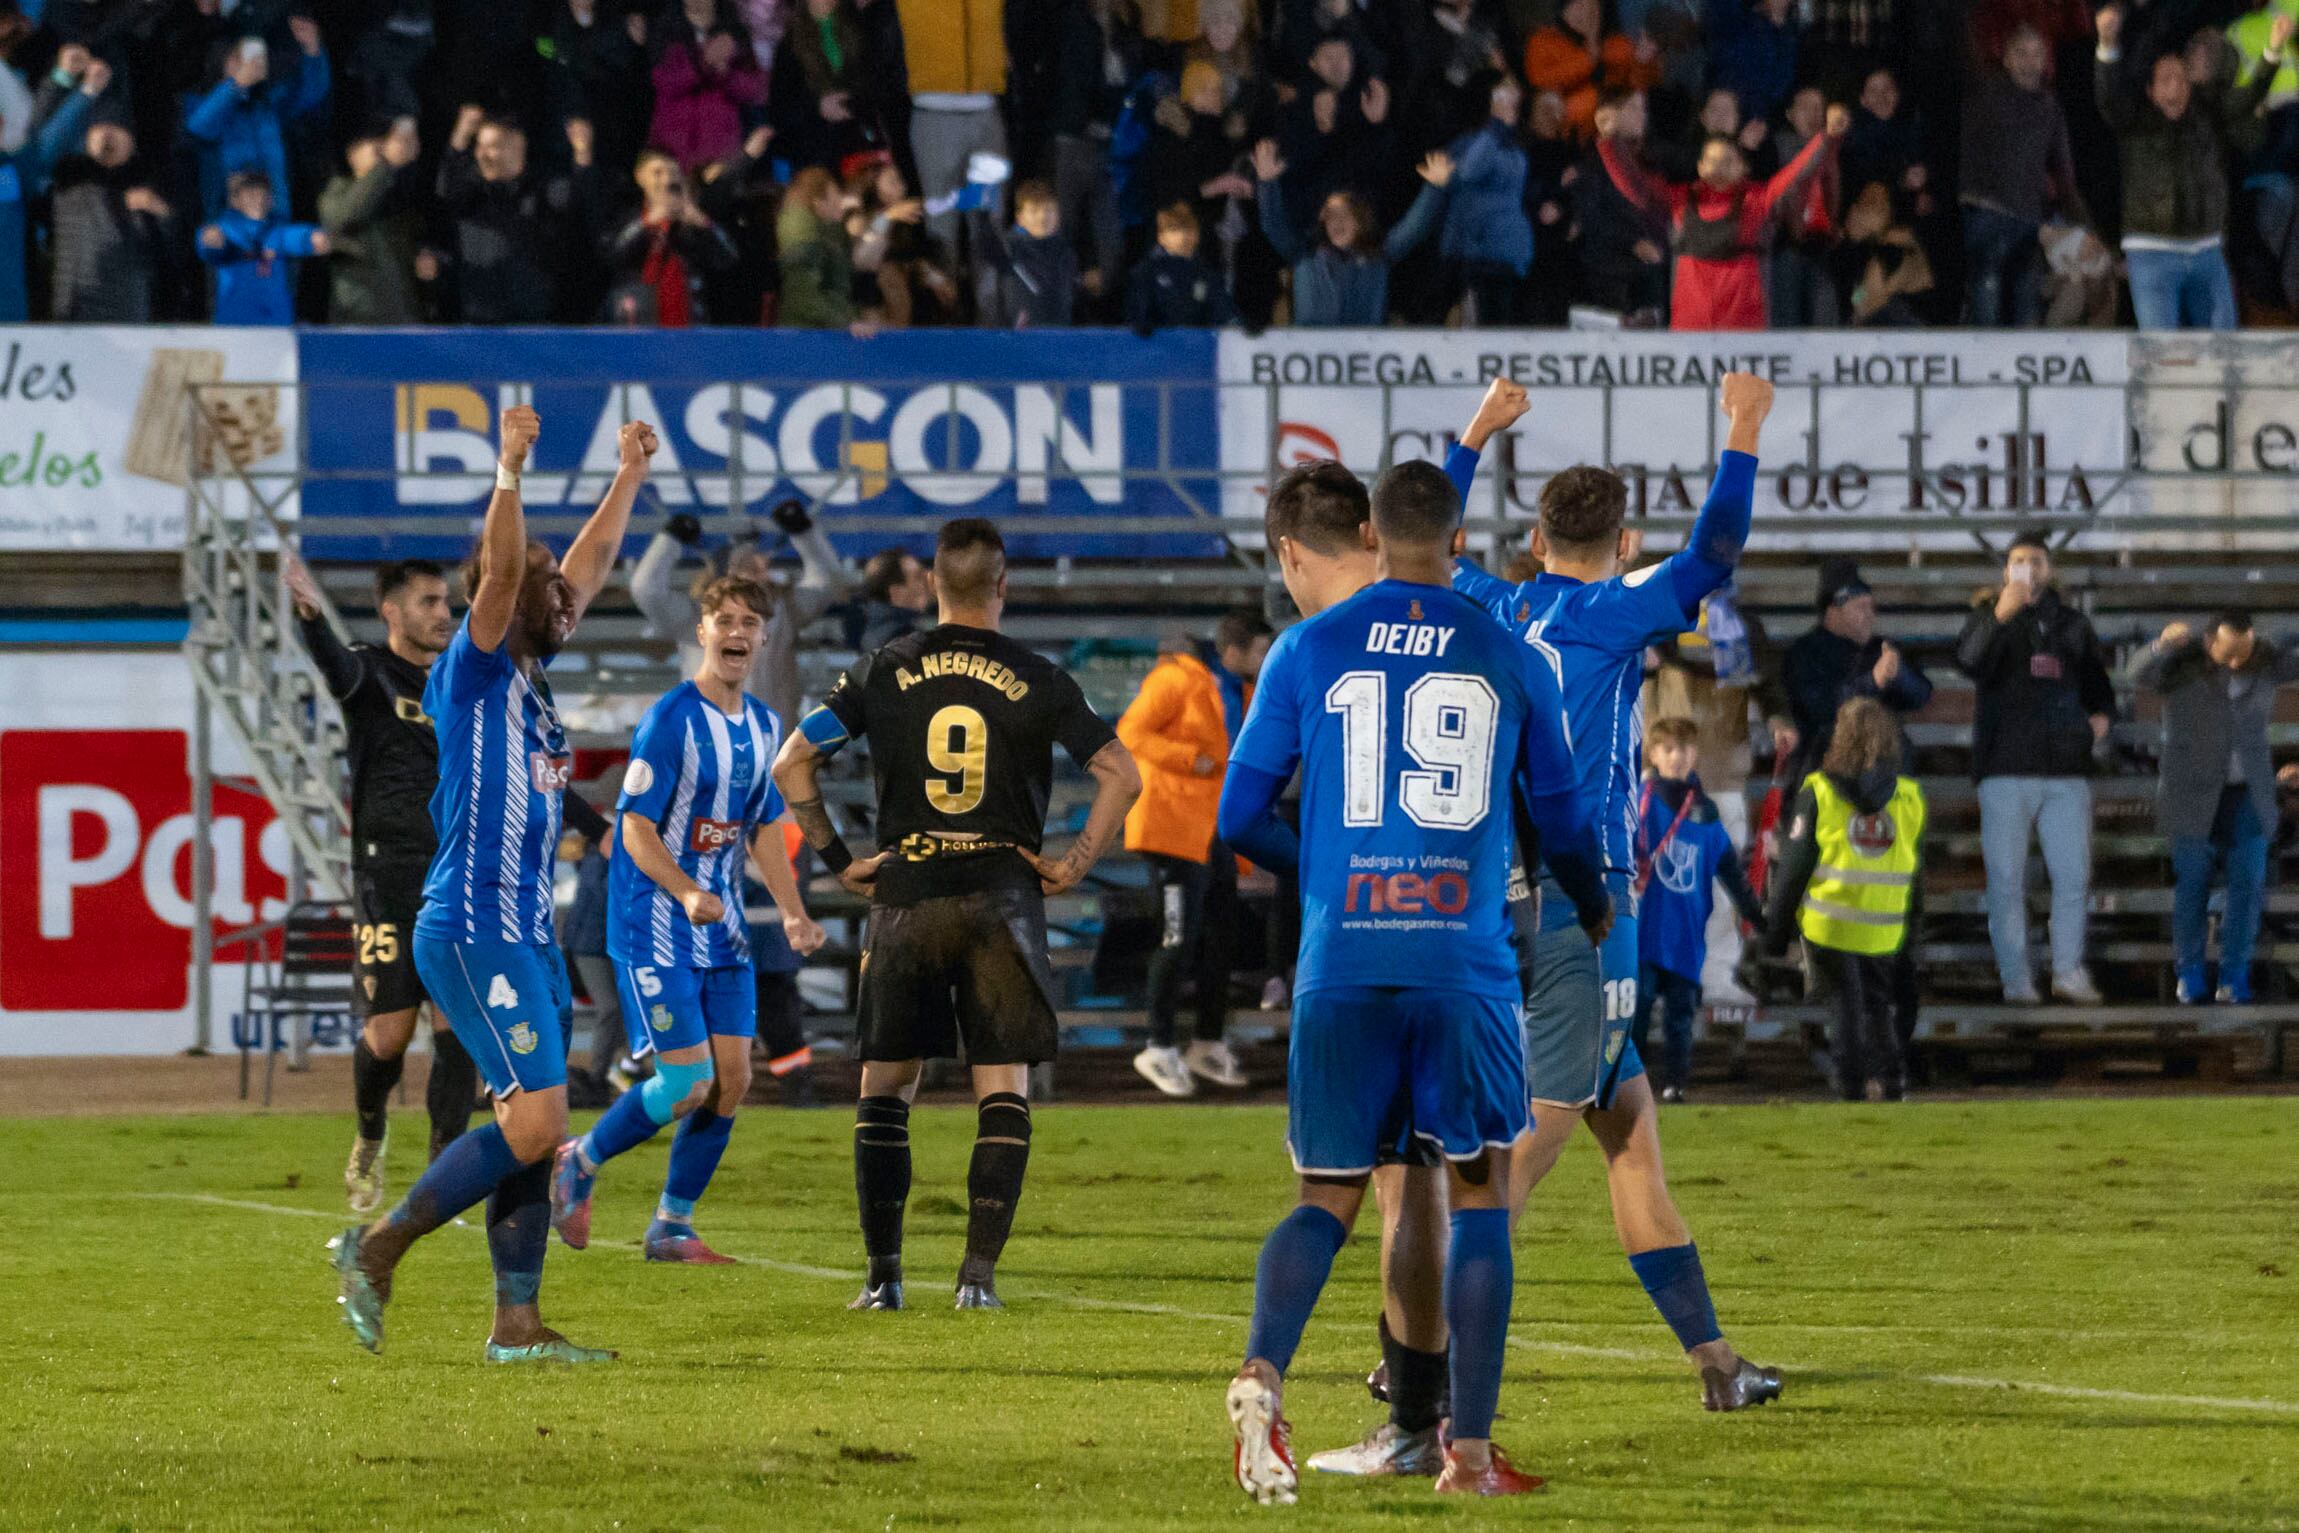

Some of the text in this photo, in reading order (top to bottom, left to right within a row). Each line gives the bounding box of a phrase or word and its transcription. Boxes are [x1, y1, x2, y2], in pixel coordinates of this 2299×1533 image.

[1251, 353, 1435, 385] BODEGA
[1479, 354, 1791, 386] RESTAURANTE
[1834, 355, 1961, 386] HOTEL
[2015, 355, 2094, 386] SPA
[395, 381, 1123, 506] BLASGON
[1777, 430, 1870, 512] de
[1366, 622, 1456, 657] DEIBY
[895, 651, 1030, 702] A. NEGREDO
[925, 704, 987, 814] 9
[1325, 671, 1500, 831] 19
[1350, 853, 1471, 871] Bodegas y Viñedos
[1344, 872, 1470, 914] neo
[360, 923, 398, 965] 25
[1341, 917, 1469, 932] www.bodegasneo.com
[487, 973, 519, 1010] 4
[635, 966, 663, 998] 5
[1603, 978, 1638, 1021] 18
